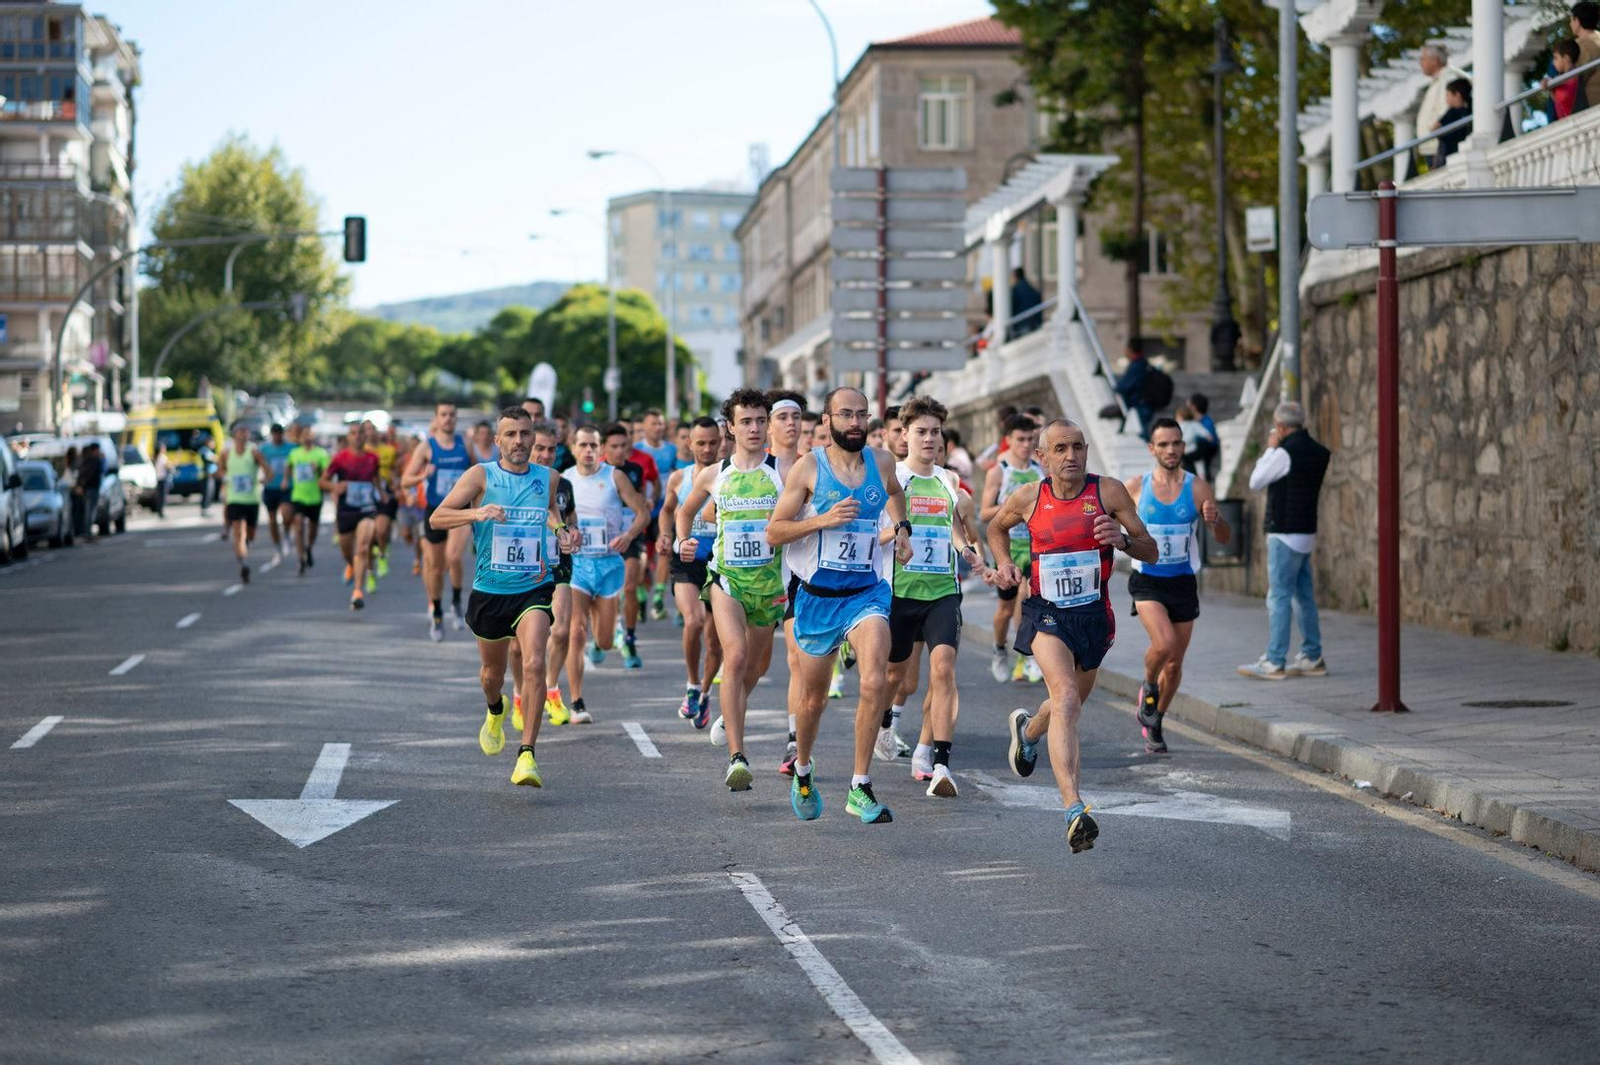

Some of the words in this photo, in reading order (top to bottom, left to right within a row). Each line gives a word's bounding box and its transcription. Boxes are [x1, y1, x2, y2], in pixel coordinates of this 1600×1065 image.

[507, 546, 525, 563] 64
[734, 541, 761, 558] 508
[838, 541, 857, 561] 24
[924, 546, 934, 563] 2
[1164, 542, 1171, 557] 3
[1056, 577, 1083, 597] 108
